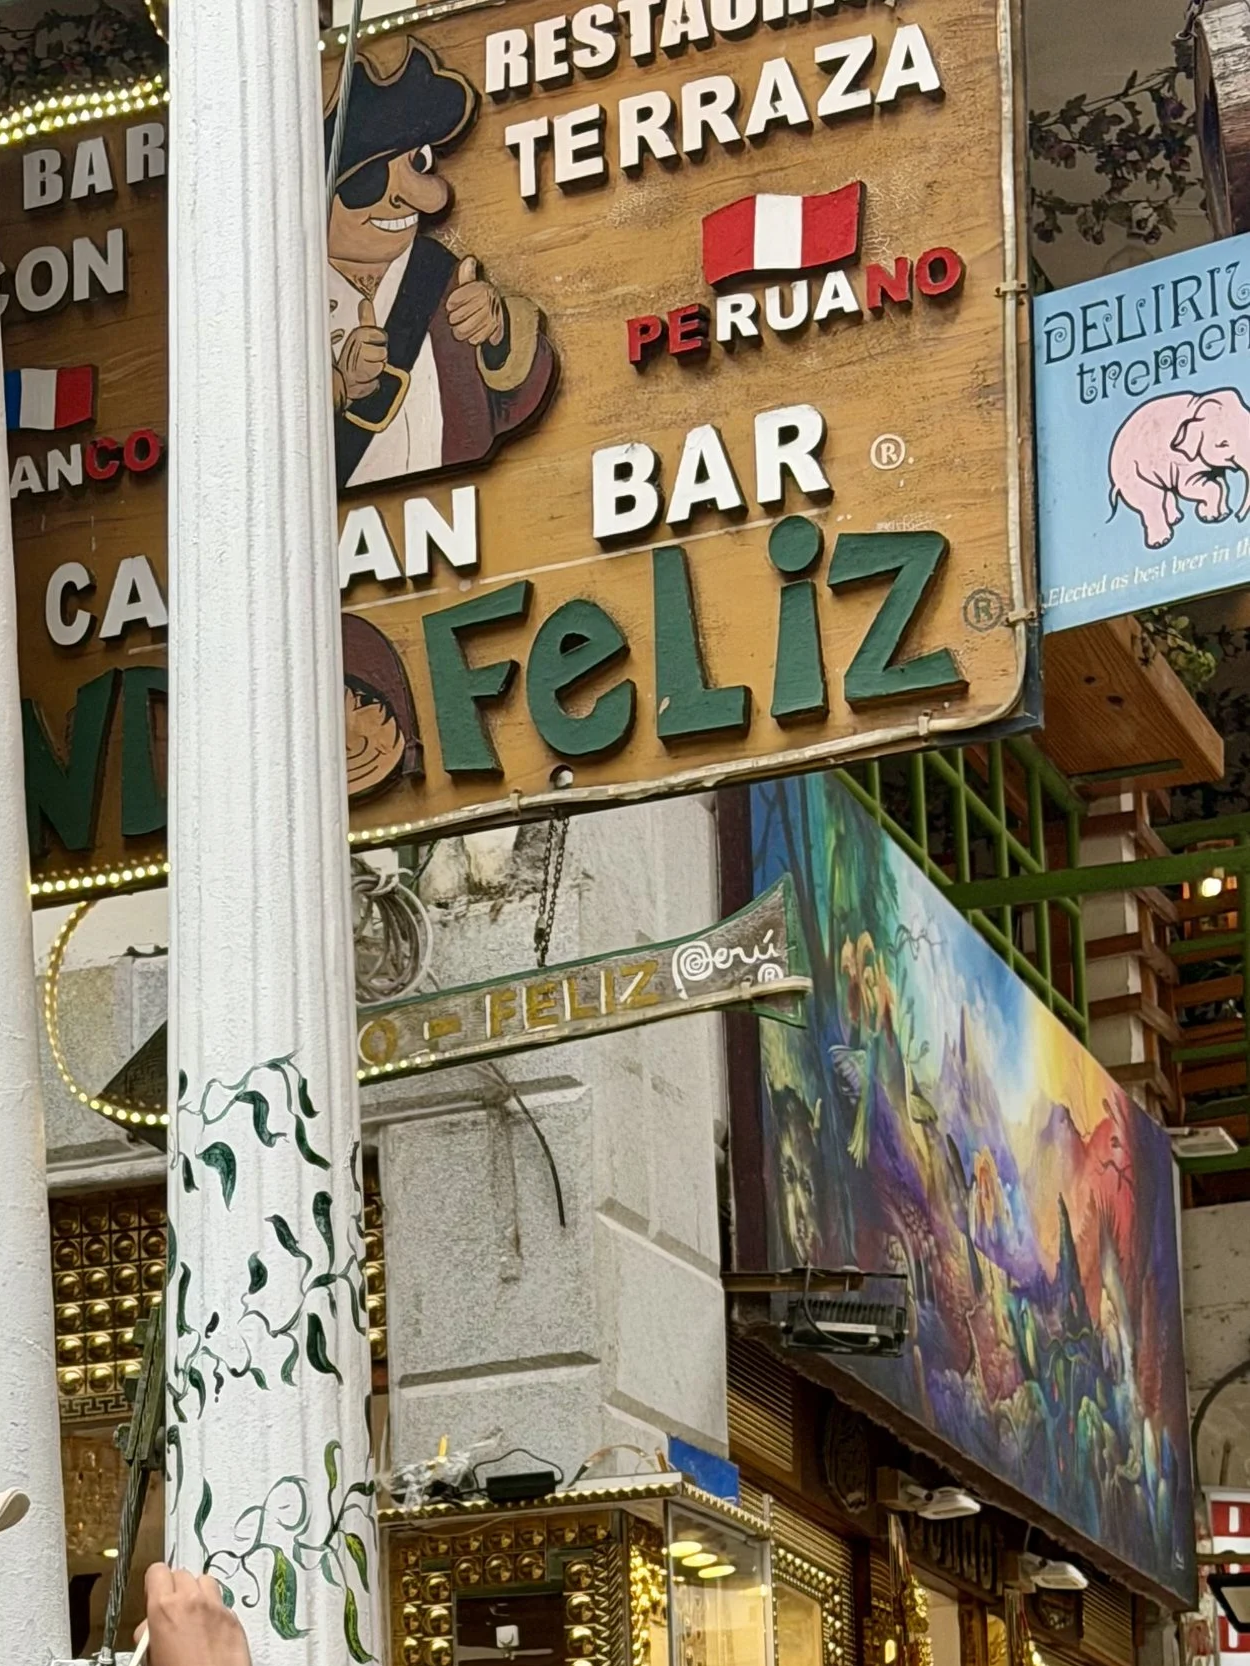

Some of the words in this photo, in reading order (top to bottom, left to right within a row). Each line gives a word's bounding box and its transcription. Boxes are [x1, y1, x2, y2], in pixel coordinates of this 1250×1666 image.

[485, 0, 843, 94] RESTAU
[505, 23, 941, 197] TERRAZA
[23, 122, 165, 210] BAR
[625, 246, 963, 363] PERUANO
[592, 403, 831, 539] BAR
[1049, 575, 1107, 607] Elected
[1111, 574, 1130, 590] as
[1134, 560, 1167, 585] best
[1171, 553, 1209, 575] beer
[1212, 545, 1231, 564] in
[485, 960, 660, 1039] FELIZ
